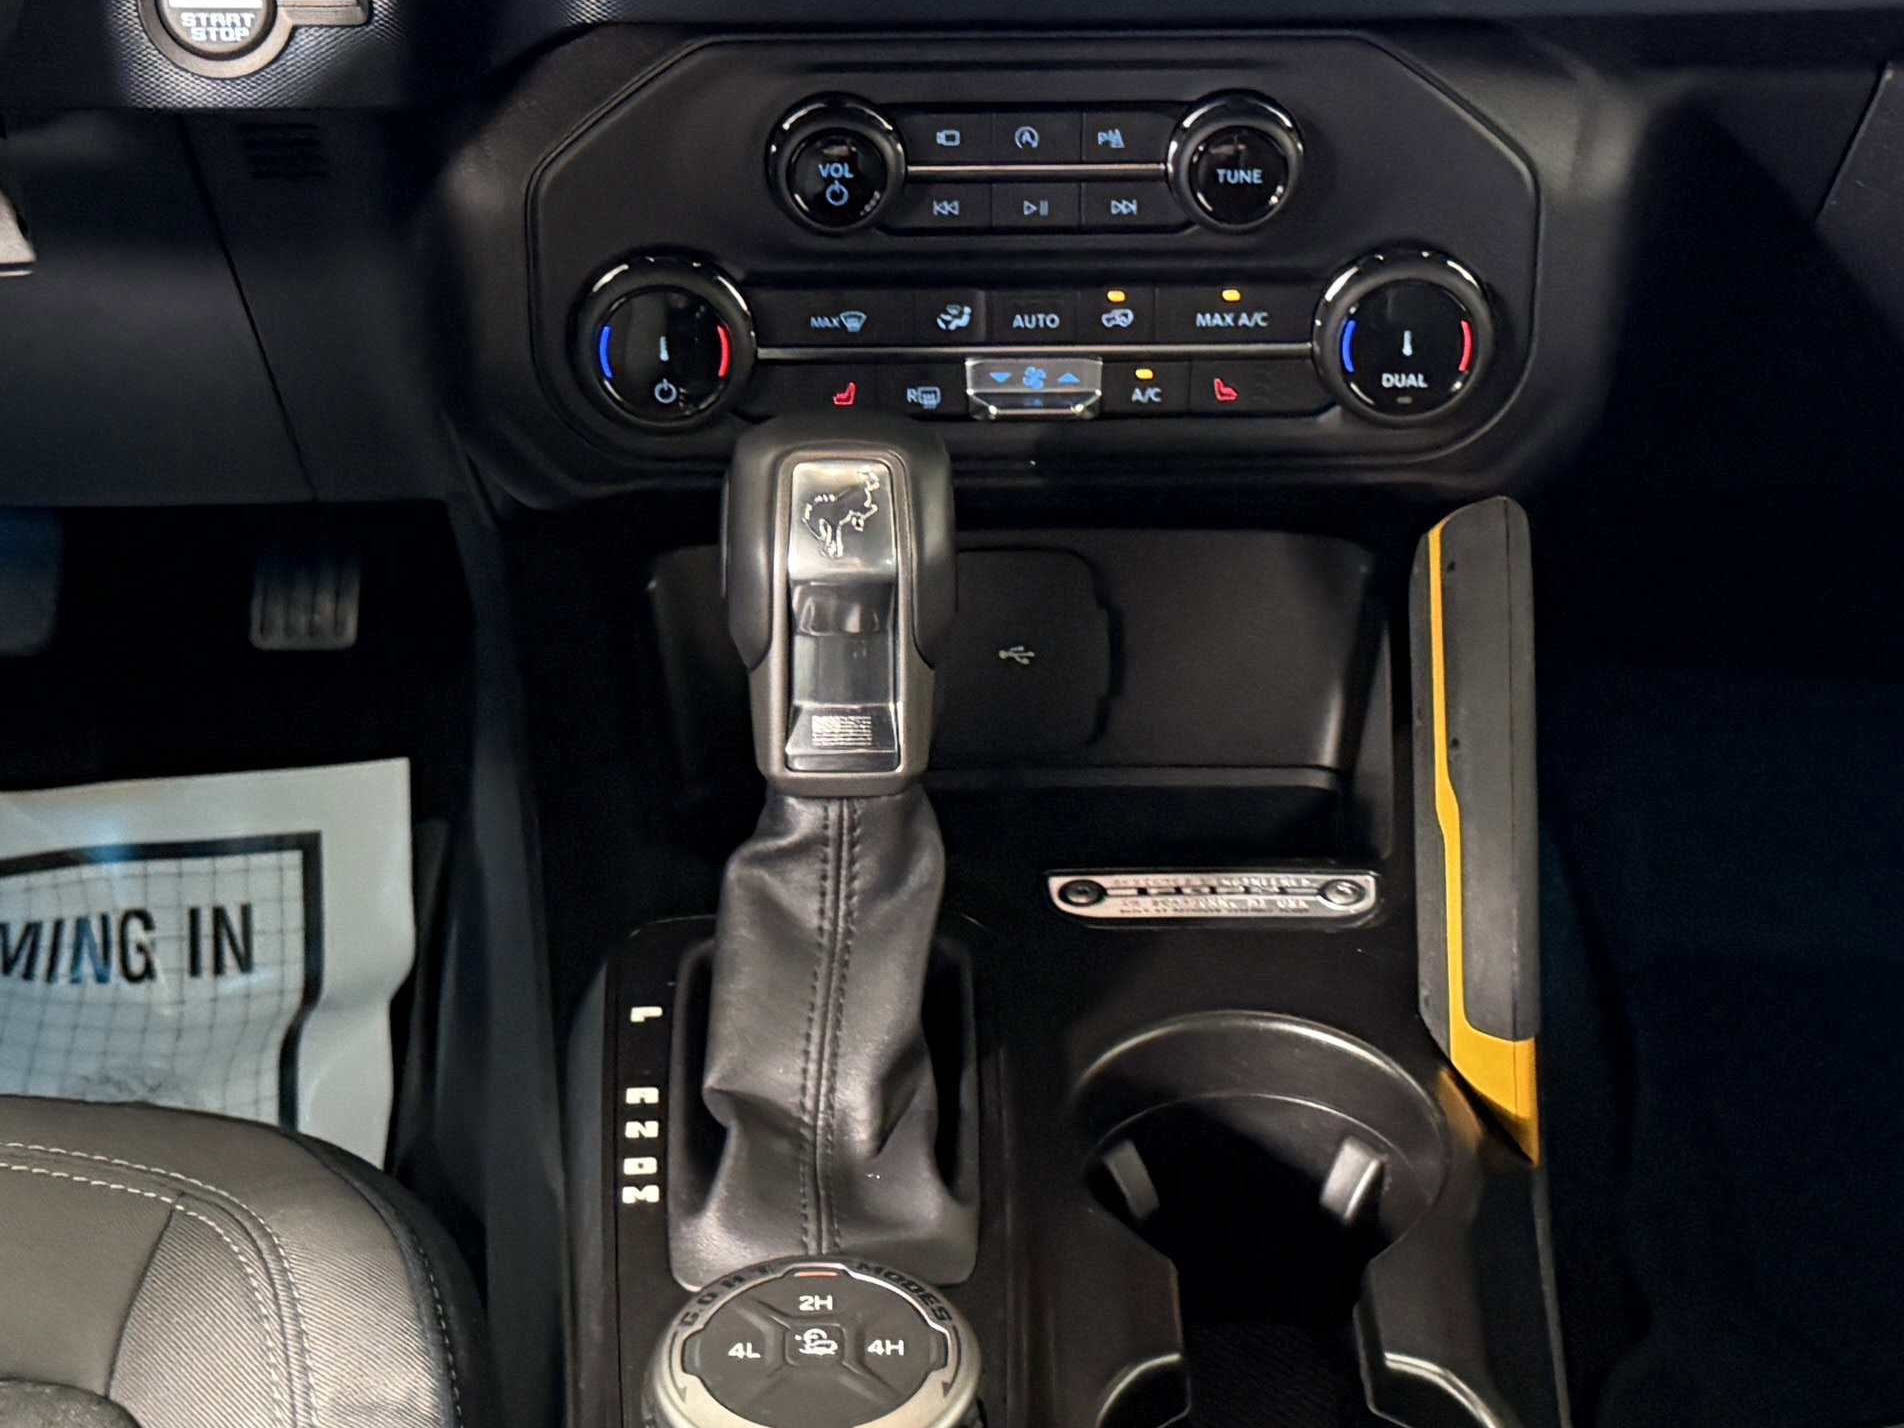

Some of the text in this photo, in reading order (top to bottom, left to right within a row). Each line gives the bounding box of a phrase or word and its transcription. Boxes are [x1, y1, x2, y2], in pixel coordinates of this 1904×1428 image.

[180, 12, 256, 28] START
[190, 27, 250, 43] STOP
[818, 163, 854, 180] VOL
[1216, 168, 1263, 185] TUNE
[810, 315, 839, 330] MAX
[1012, 313, 1060, 330] AUTO
[1196, 312, 1269, 328] MAX A/C
[1381, 372, 1428, 389] DUAL
[1131, 388, 1162, 404] A/C
[187, 901, 256, 978] IN
[624, 1120, 660, 1139] N
[621, 1184, 660, 1204] M
[855, 1262, 954, 1322] MODES
[798, 1294, 834, 1312] 2H
[727, 1342, 762, 1359] 4L
[867, 1339, 905, 1356] 4H
